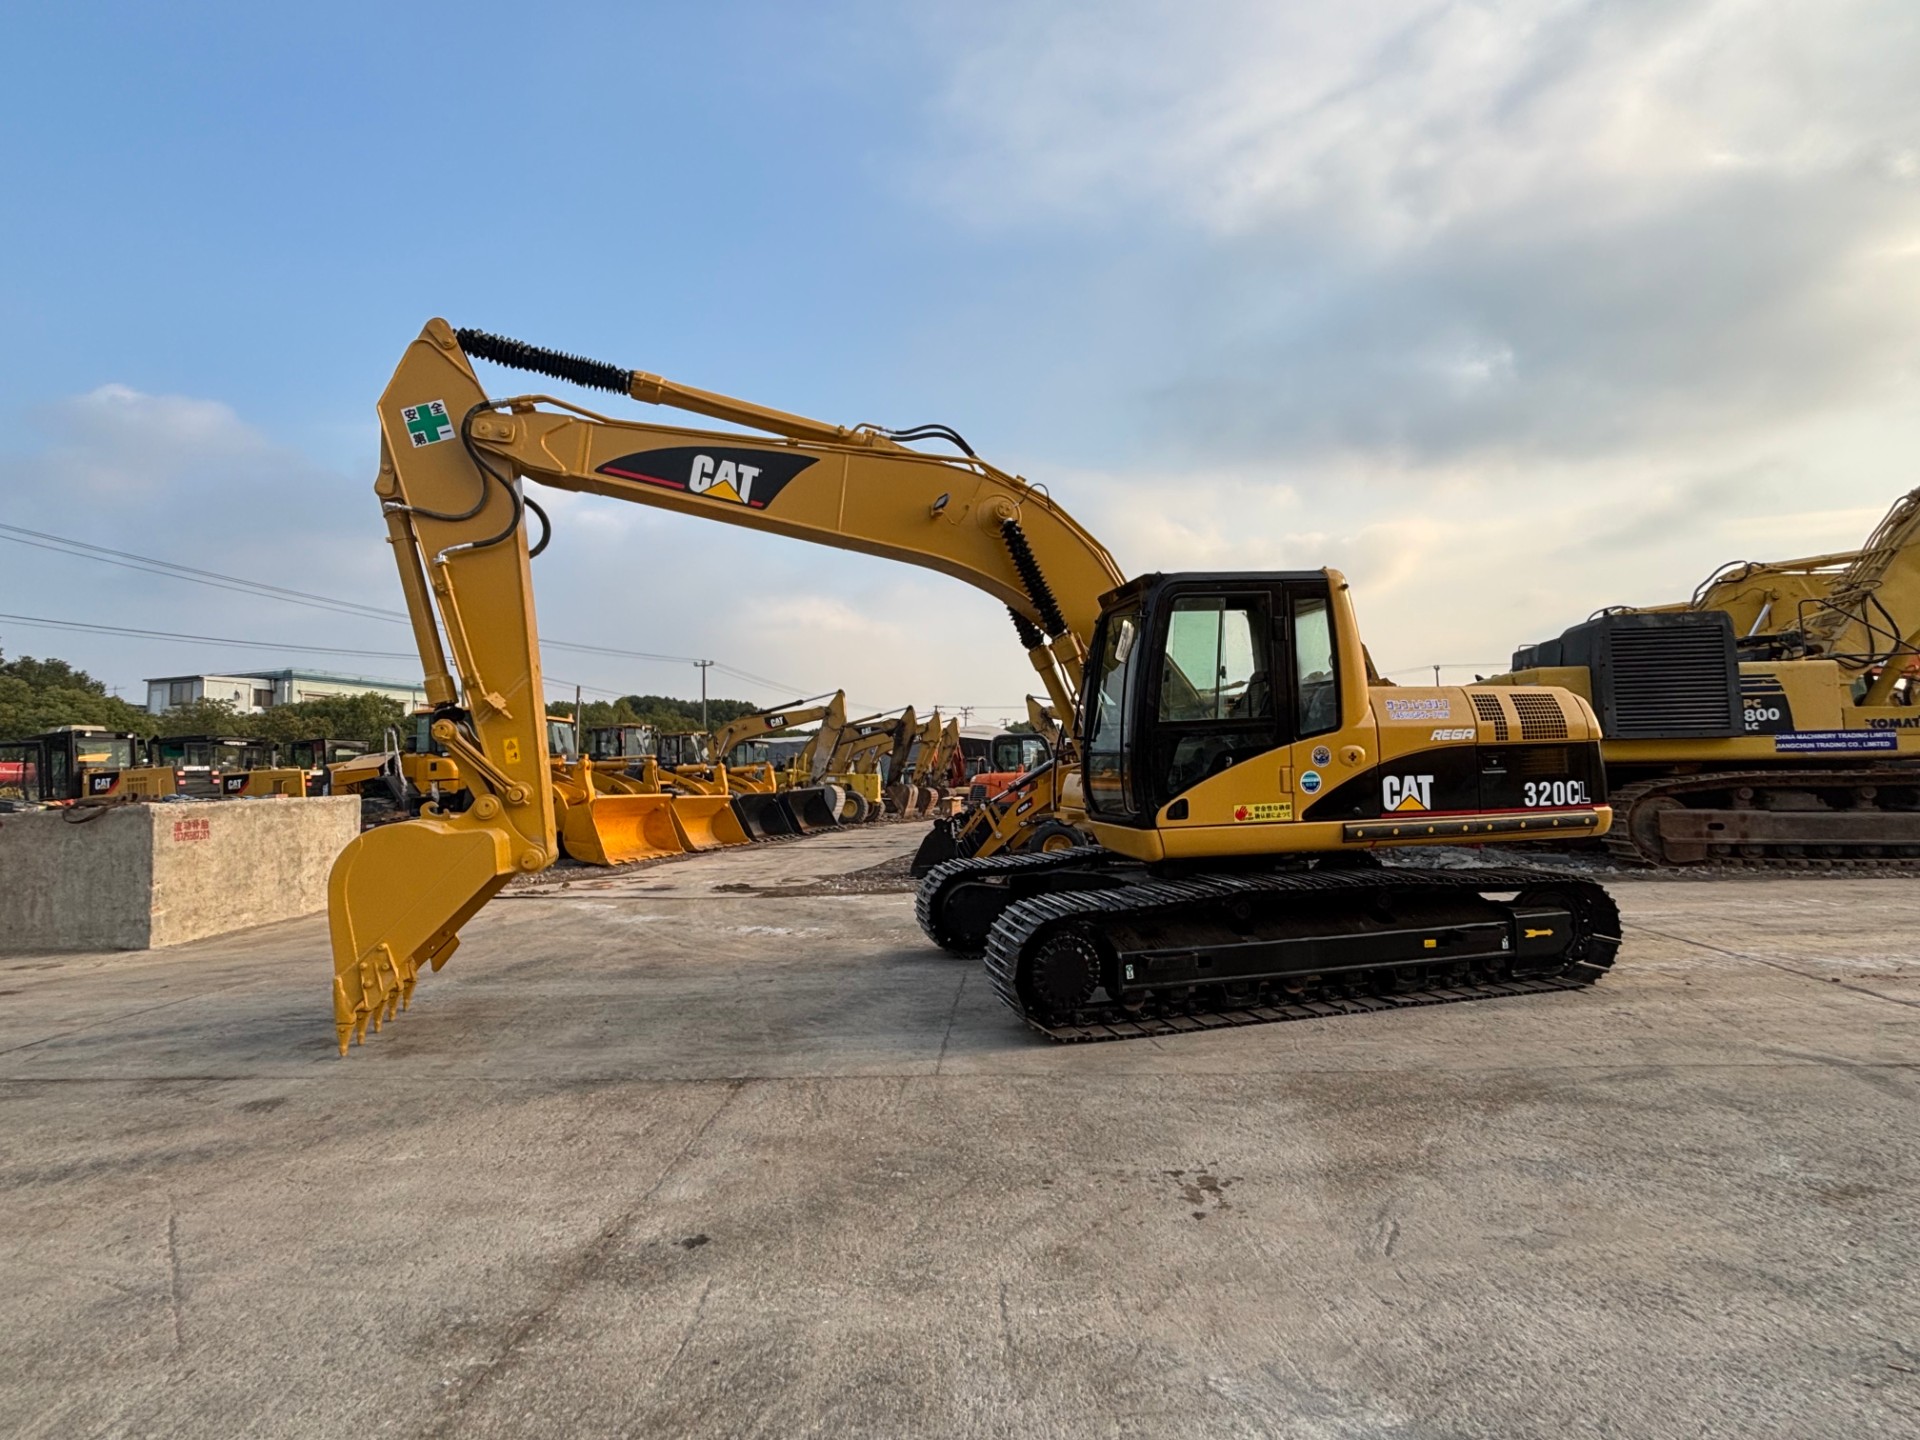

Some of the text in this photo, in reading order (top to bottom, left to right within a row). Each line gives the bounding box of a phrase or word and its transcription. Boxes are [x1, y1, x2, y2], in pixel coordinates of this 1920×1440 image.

[689, 454, 760, 504] CAT
[1743, 698, 1762, 708] PC
[1743, 708, 1780, 721] 800
[769, 717, 784, 728] CAT
[1744, 722, 1760, 730] LC
[95, 778, 112, 790] CAT
[228, 779, 242, 789] CAT
[1382, 775, 1434, 811] CAT
